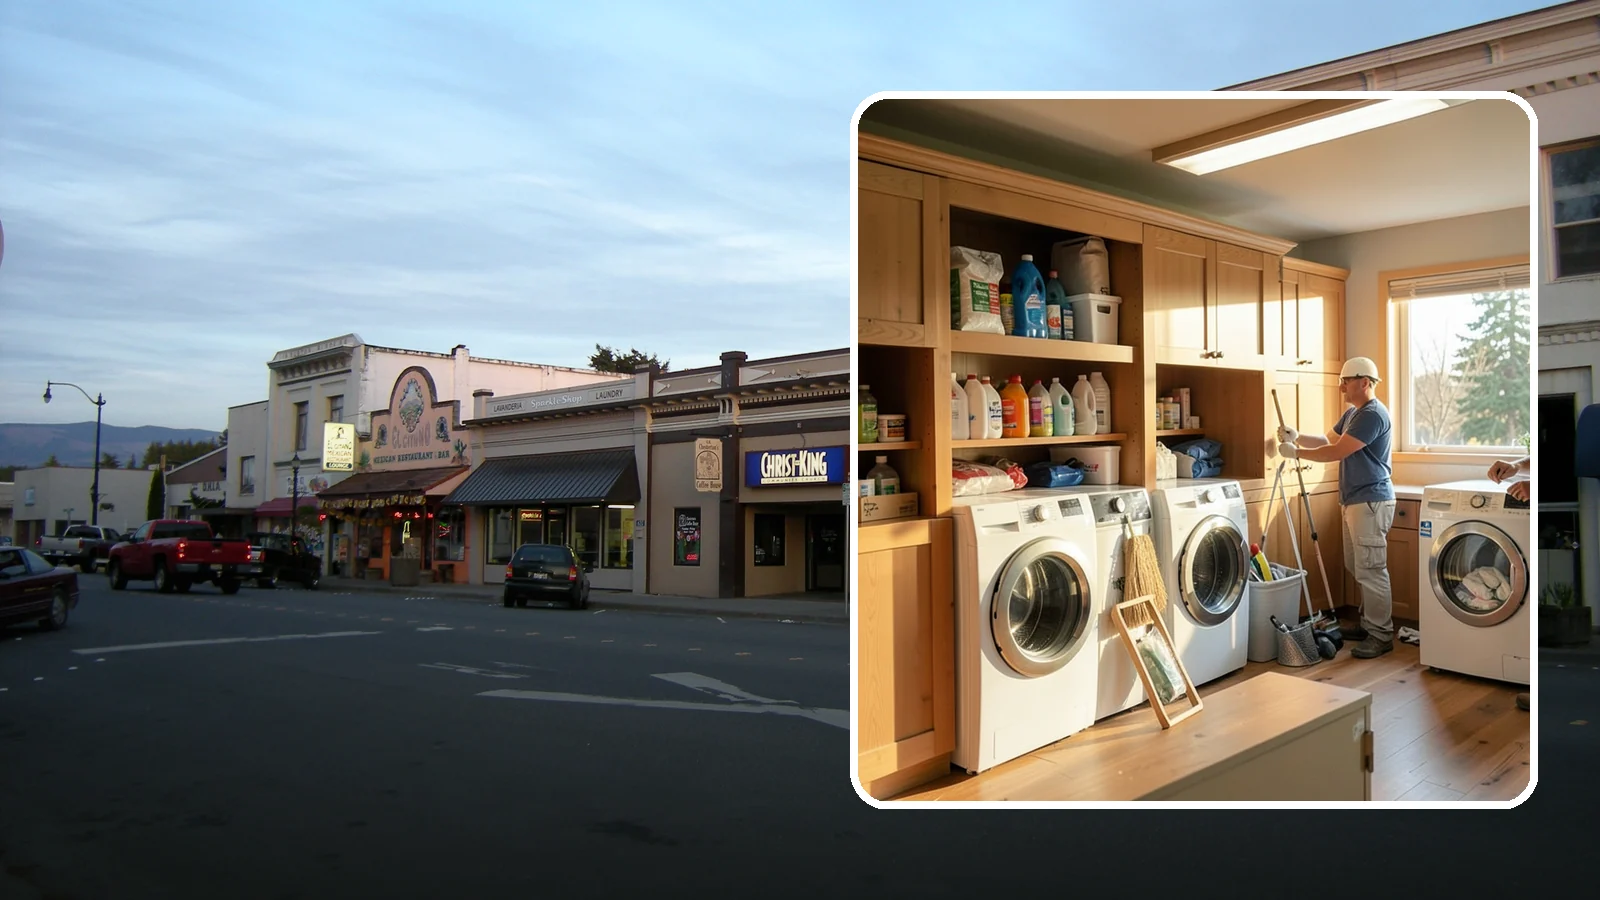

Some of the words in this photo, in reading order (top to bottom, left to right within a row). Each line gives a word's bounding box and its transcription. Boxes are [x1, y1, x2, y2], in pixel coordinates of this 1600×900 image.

[561, 394, 583, 405] Shop
[595, 389, 623, 400] LAUNDRY
[493, 402, 523, 412] LAVANDERIA
[373, 455, 396, 464] MEXICAN
[398, 452, 433, 462] RESTAURANT
[437, 451, 450, 459] BAR
[761, 452, 797, 478] CHRIST
[798, 450, 827, 477] KING
[696, 480, 709, 489] Coffee
